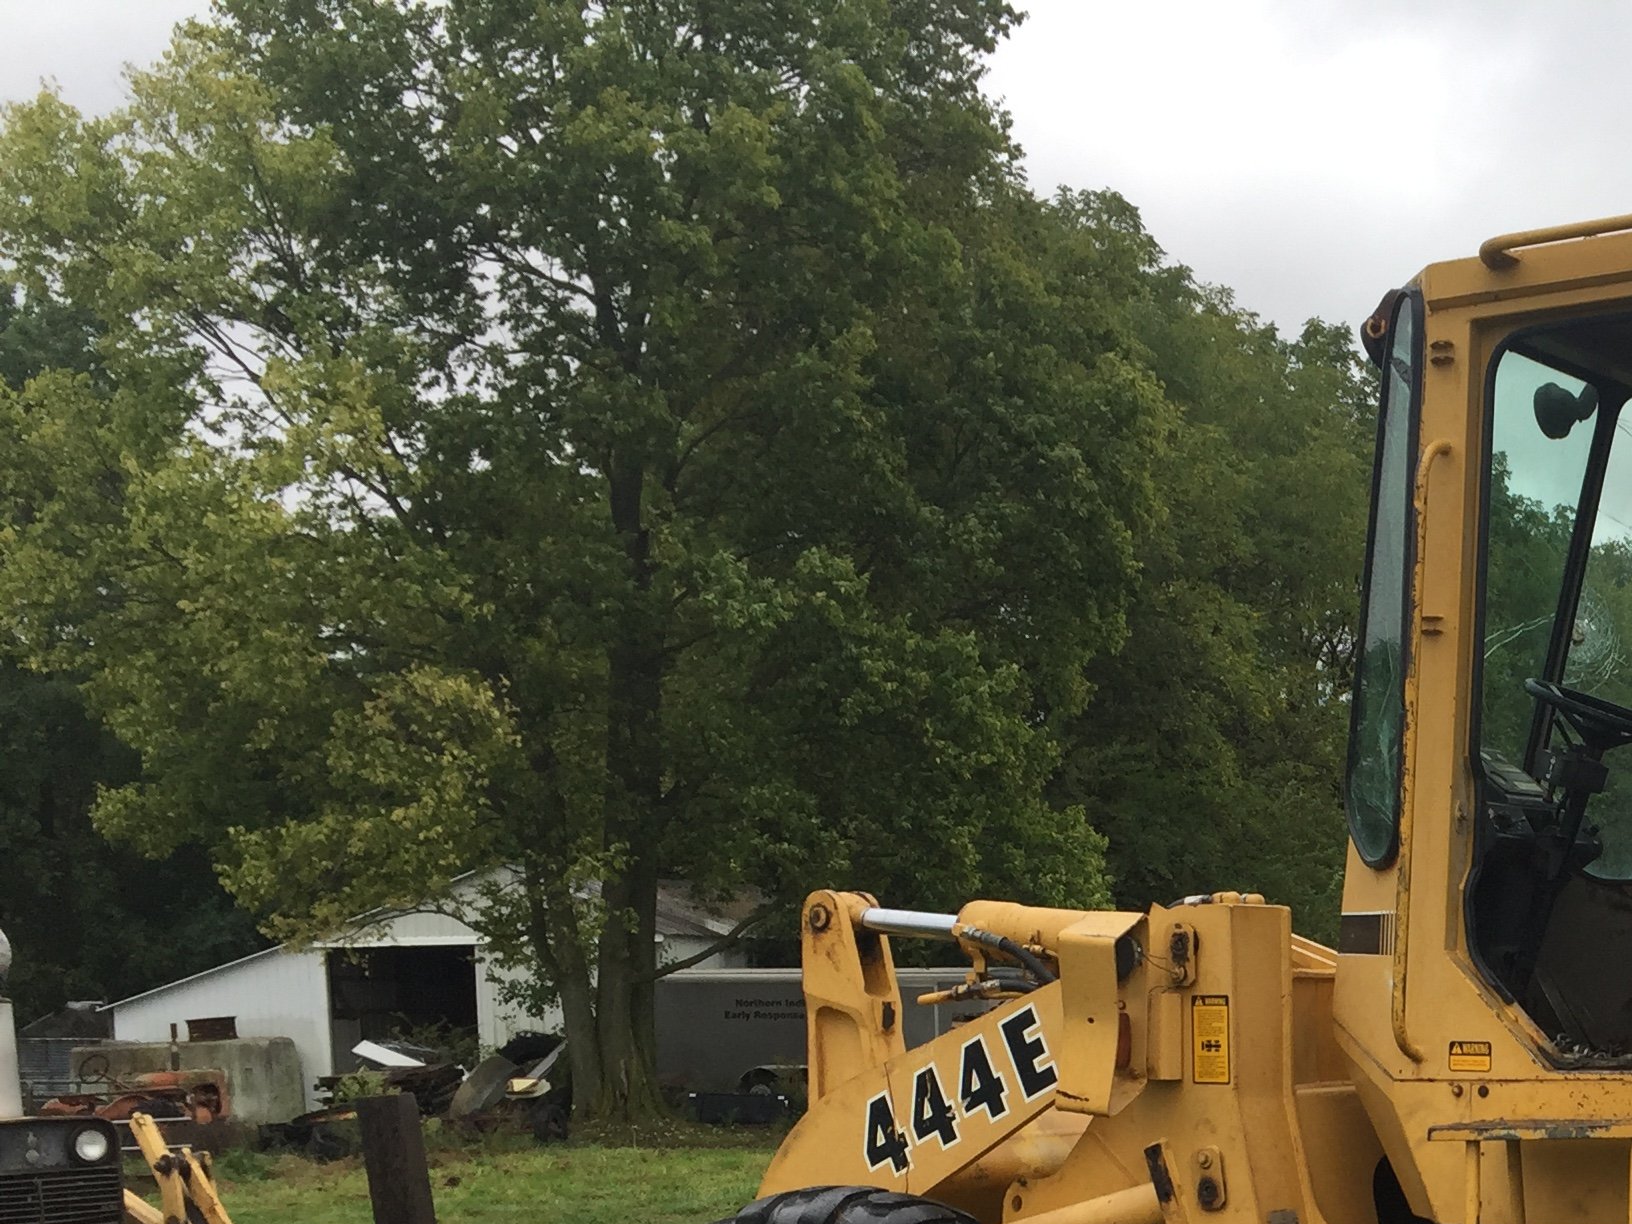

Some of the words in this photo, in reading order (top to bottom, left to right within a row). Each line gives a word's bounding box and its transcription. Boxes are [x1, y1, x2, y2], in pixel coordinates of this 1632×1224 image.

[735, 998, 782, 1008] Northern
[724, 1010, 751, 1021] Early
[864, 1002, 1059, 1179] 444E
